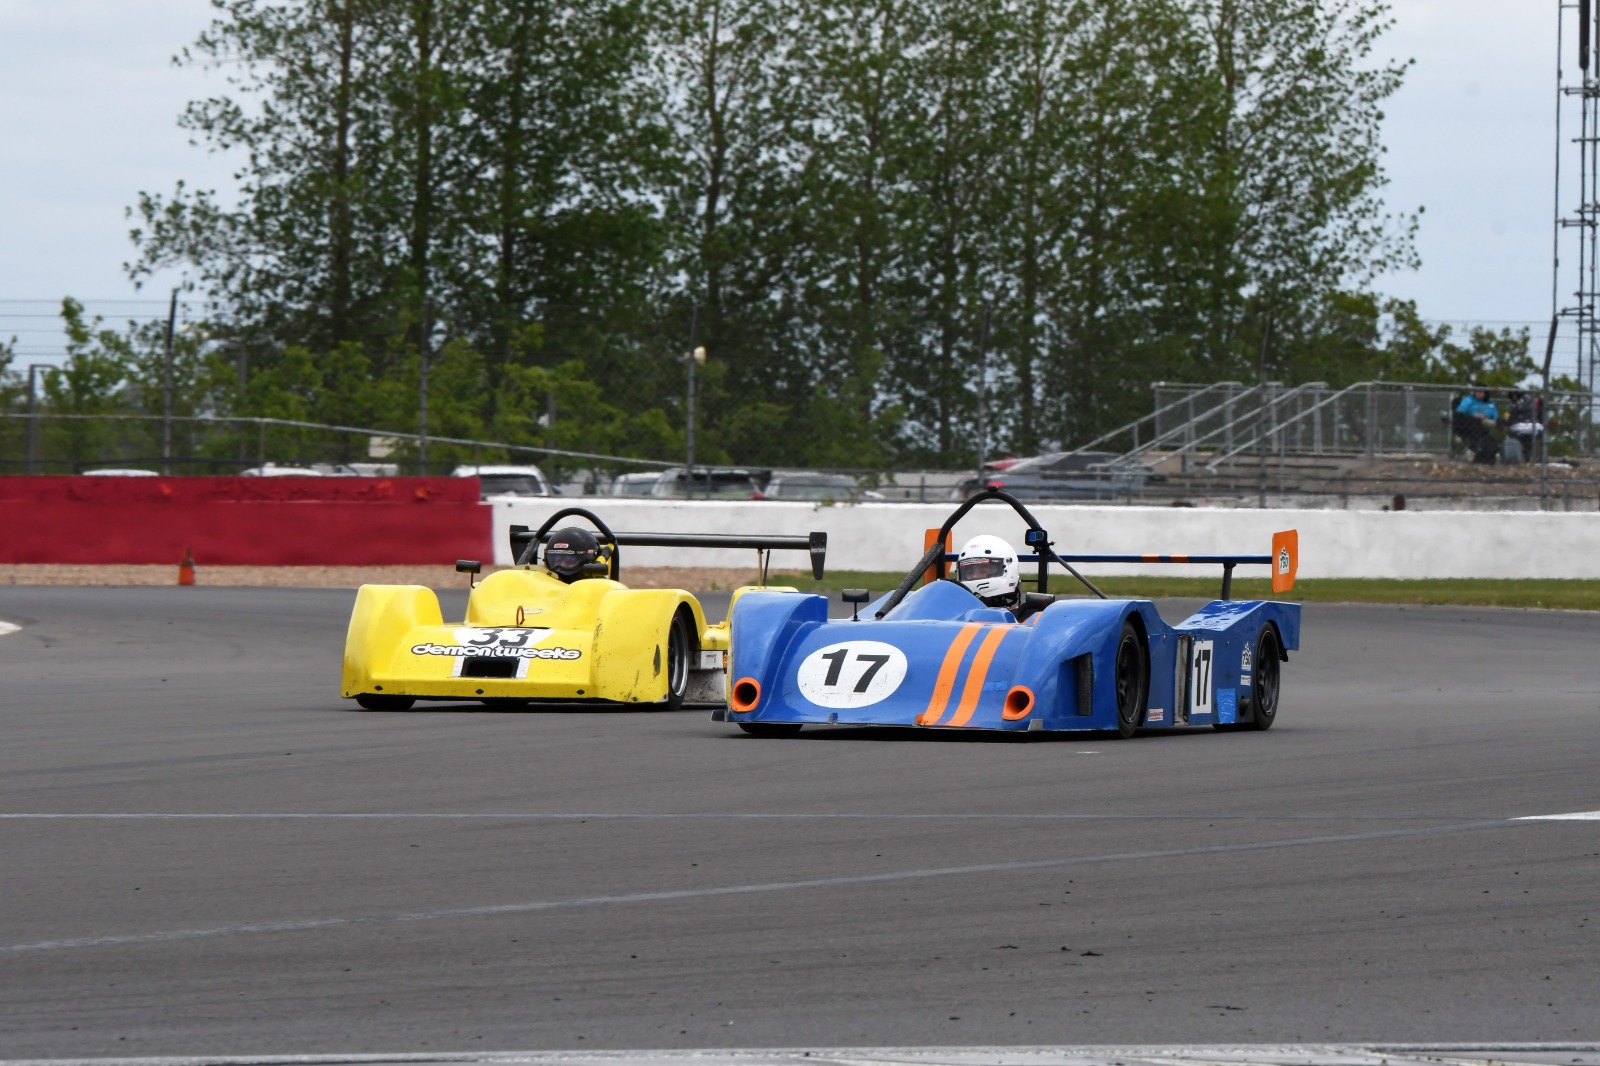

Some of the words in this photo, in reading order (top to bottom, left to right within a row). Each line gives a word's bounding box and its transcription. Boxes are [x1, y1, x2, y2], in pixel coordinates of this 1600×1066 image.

[468, 628, 535, 646] 33
[822, 649, 890, 693] 17
[1194, 649, 1211, 706] 17
